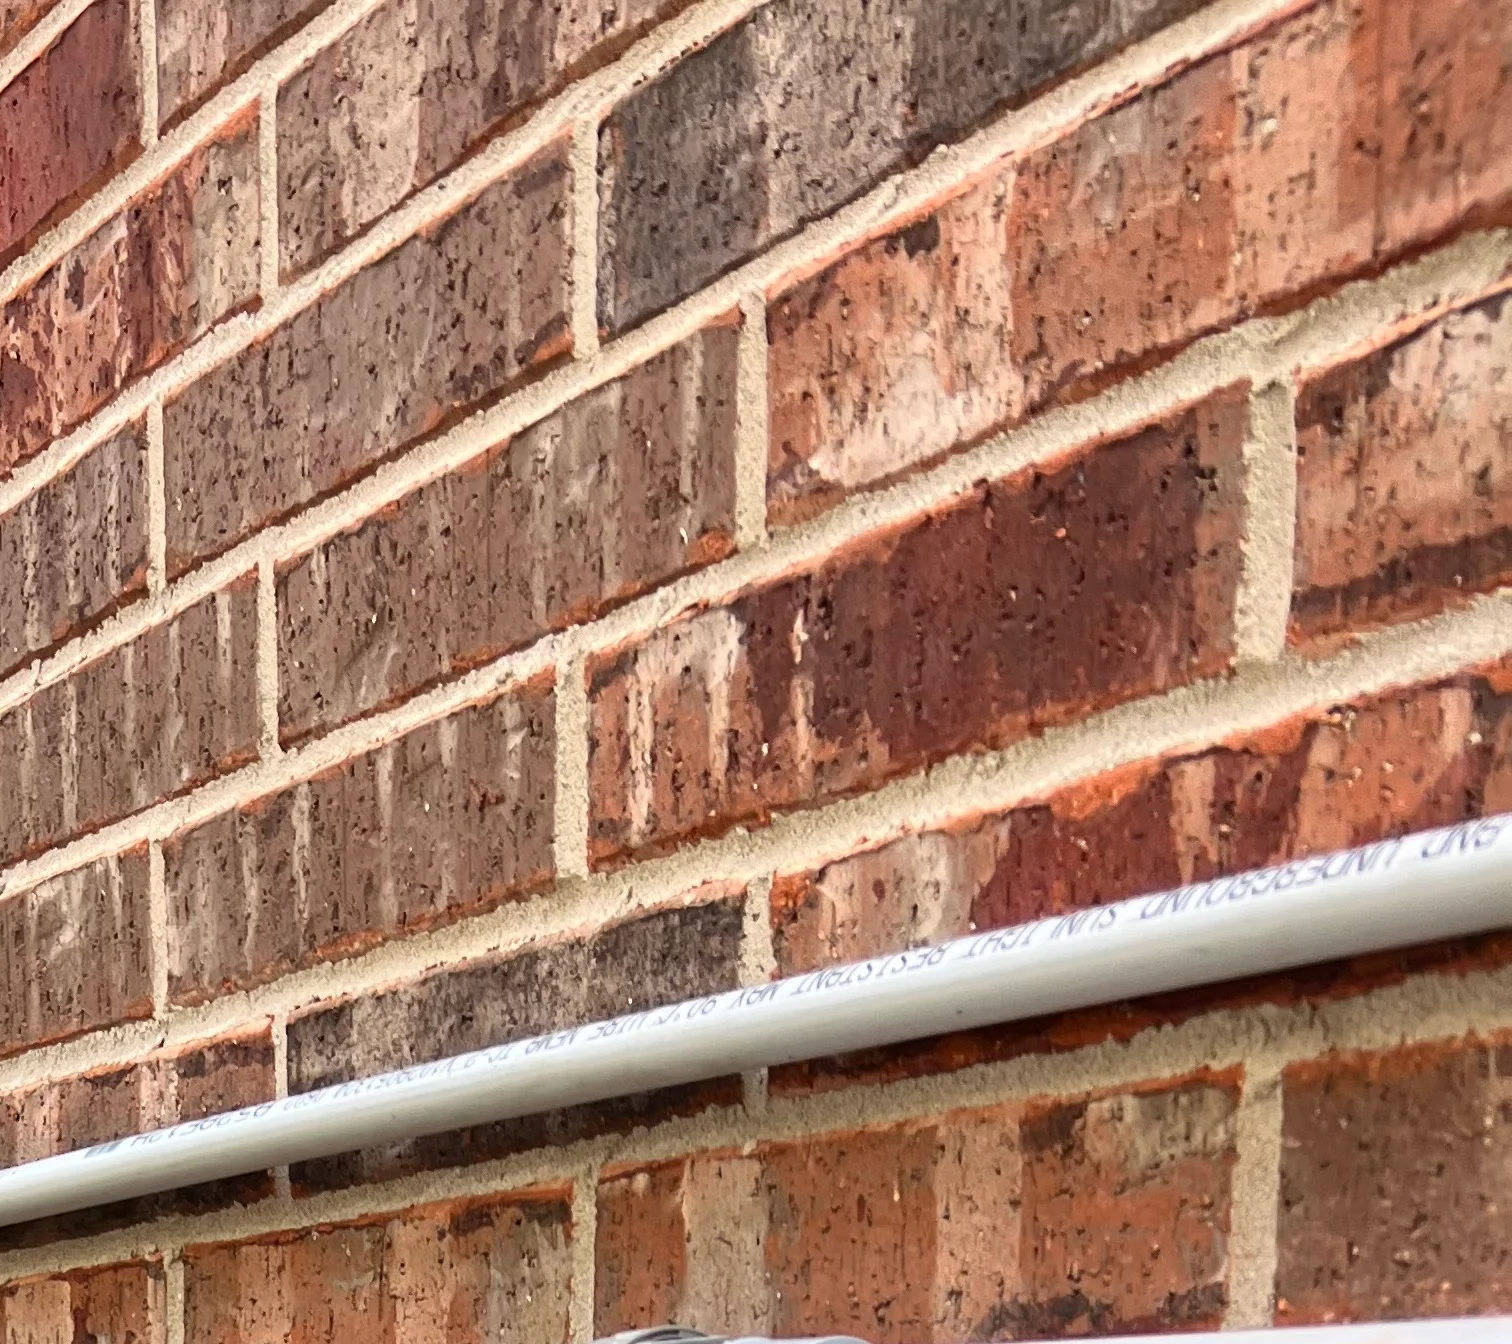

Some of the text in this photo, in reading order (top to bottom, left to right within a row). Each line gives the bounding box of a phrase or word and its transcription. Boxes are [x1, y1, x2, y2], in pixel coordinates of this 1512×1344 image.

[1138, 839, 1402, 920] UNDERGROUND
[960, 905, 1127, 959] SUNLIGHT
[789, 945, 949, 996] RESISTANT
